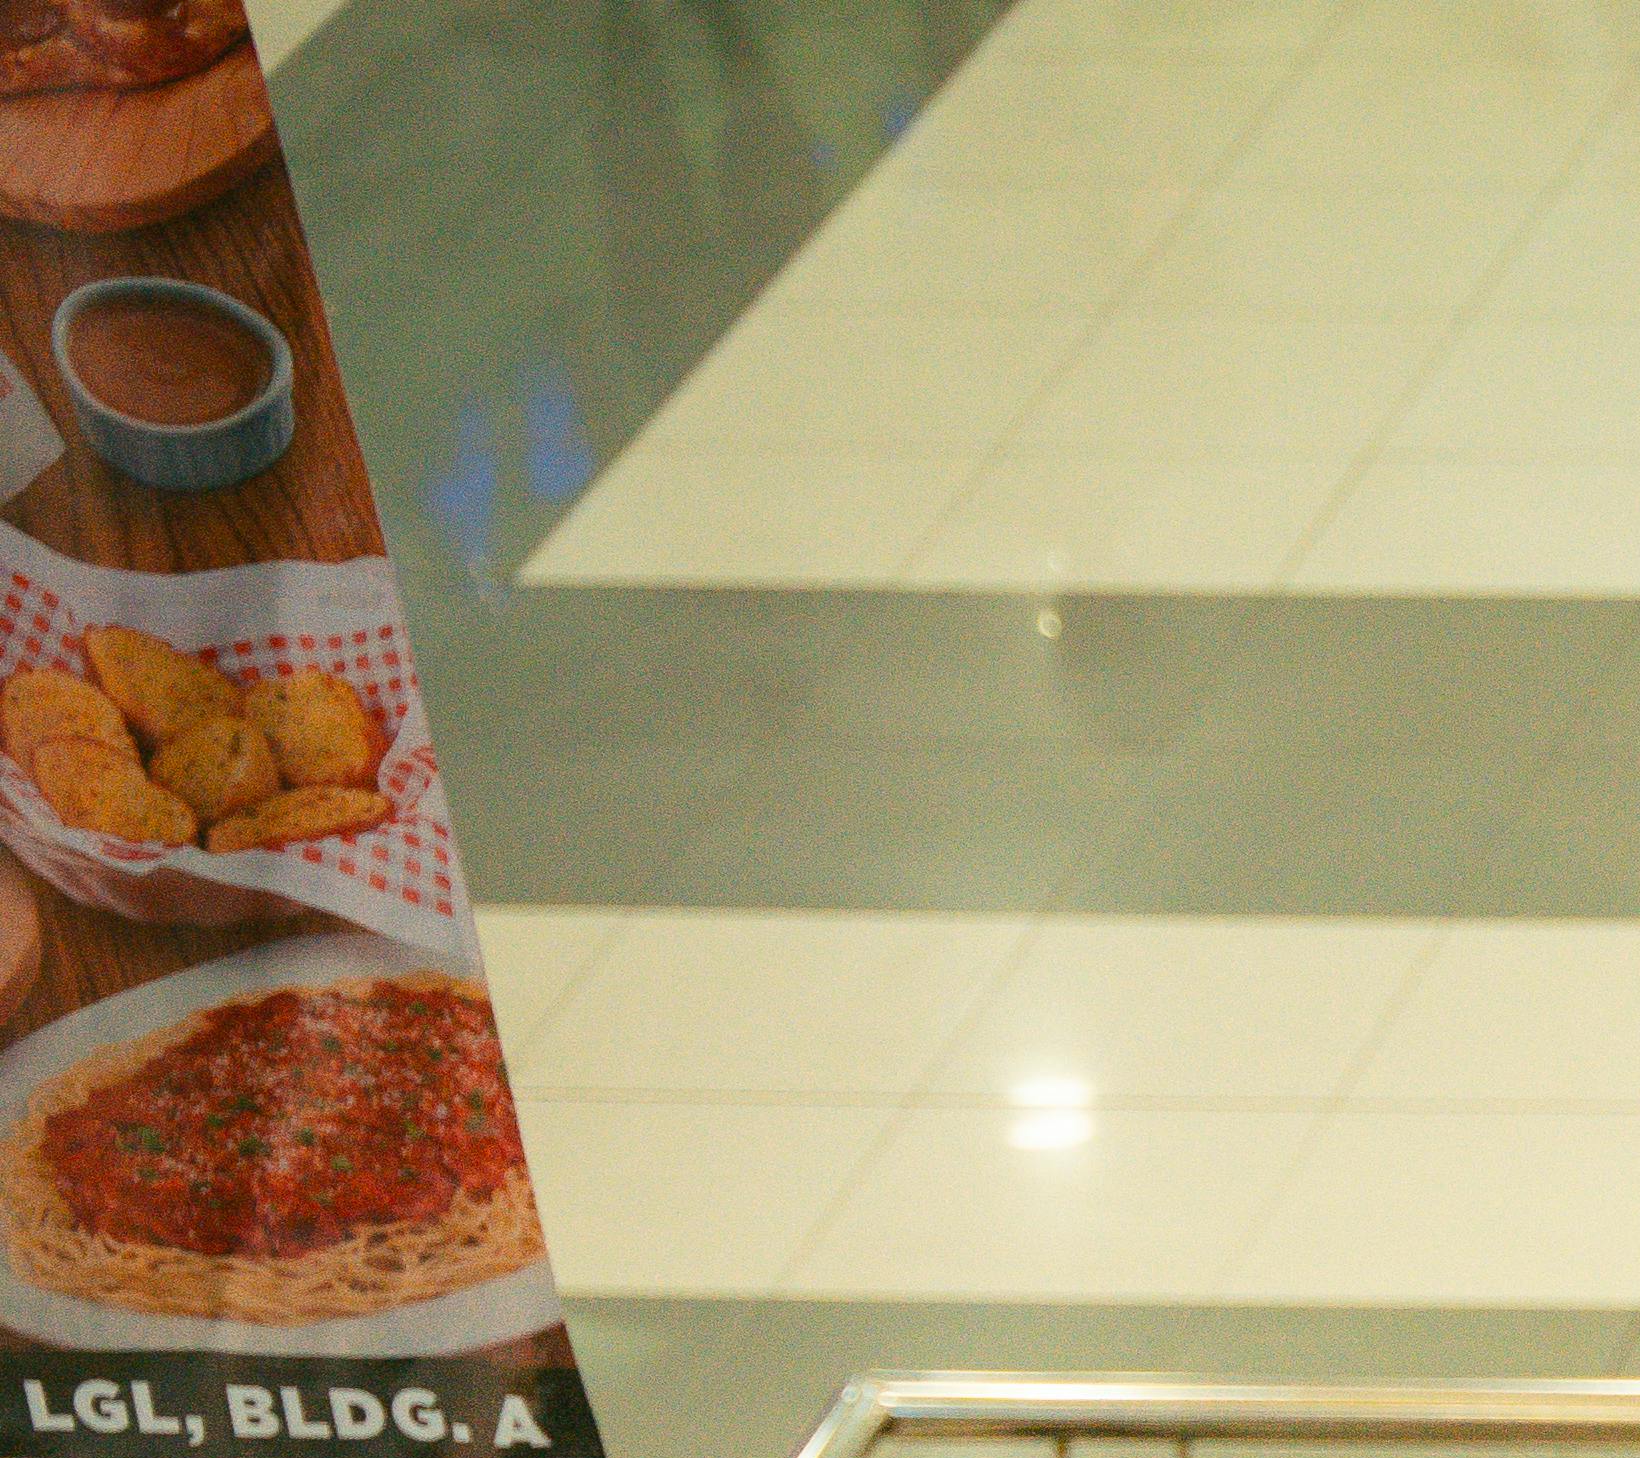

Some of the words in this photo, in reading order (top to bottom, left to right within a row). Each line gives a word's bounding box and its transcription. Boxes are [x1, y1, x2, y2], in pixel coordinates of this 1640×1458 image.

[24, 1379, 205, 1446] LGL,
[225, 1384, 471, 1443] BLDG.
[494, 1394, 551, 1449] A
